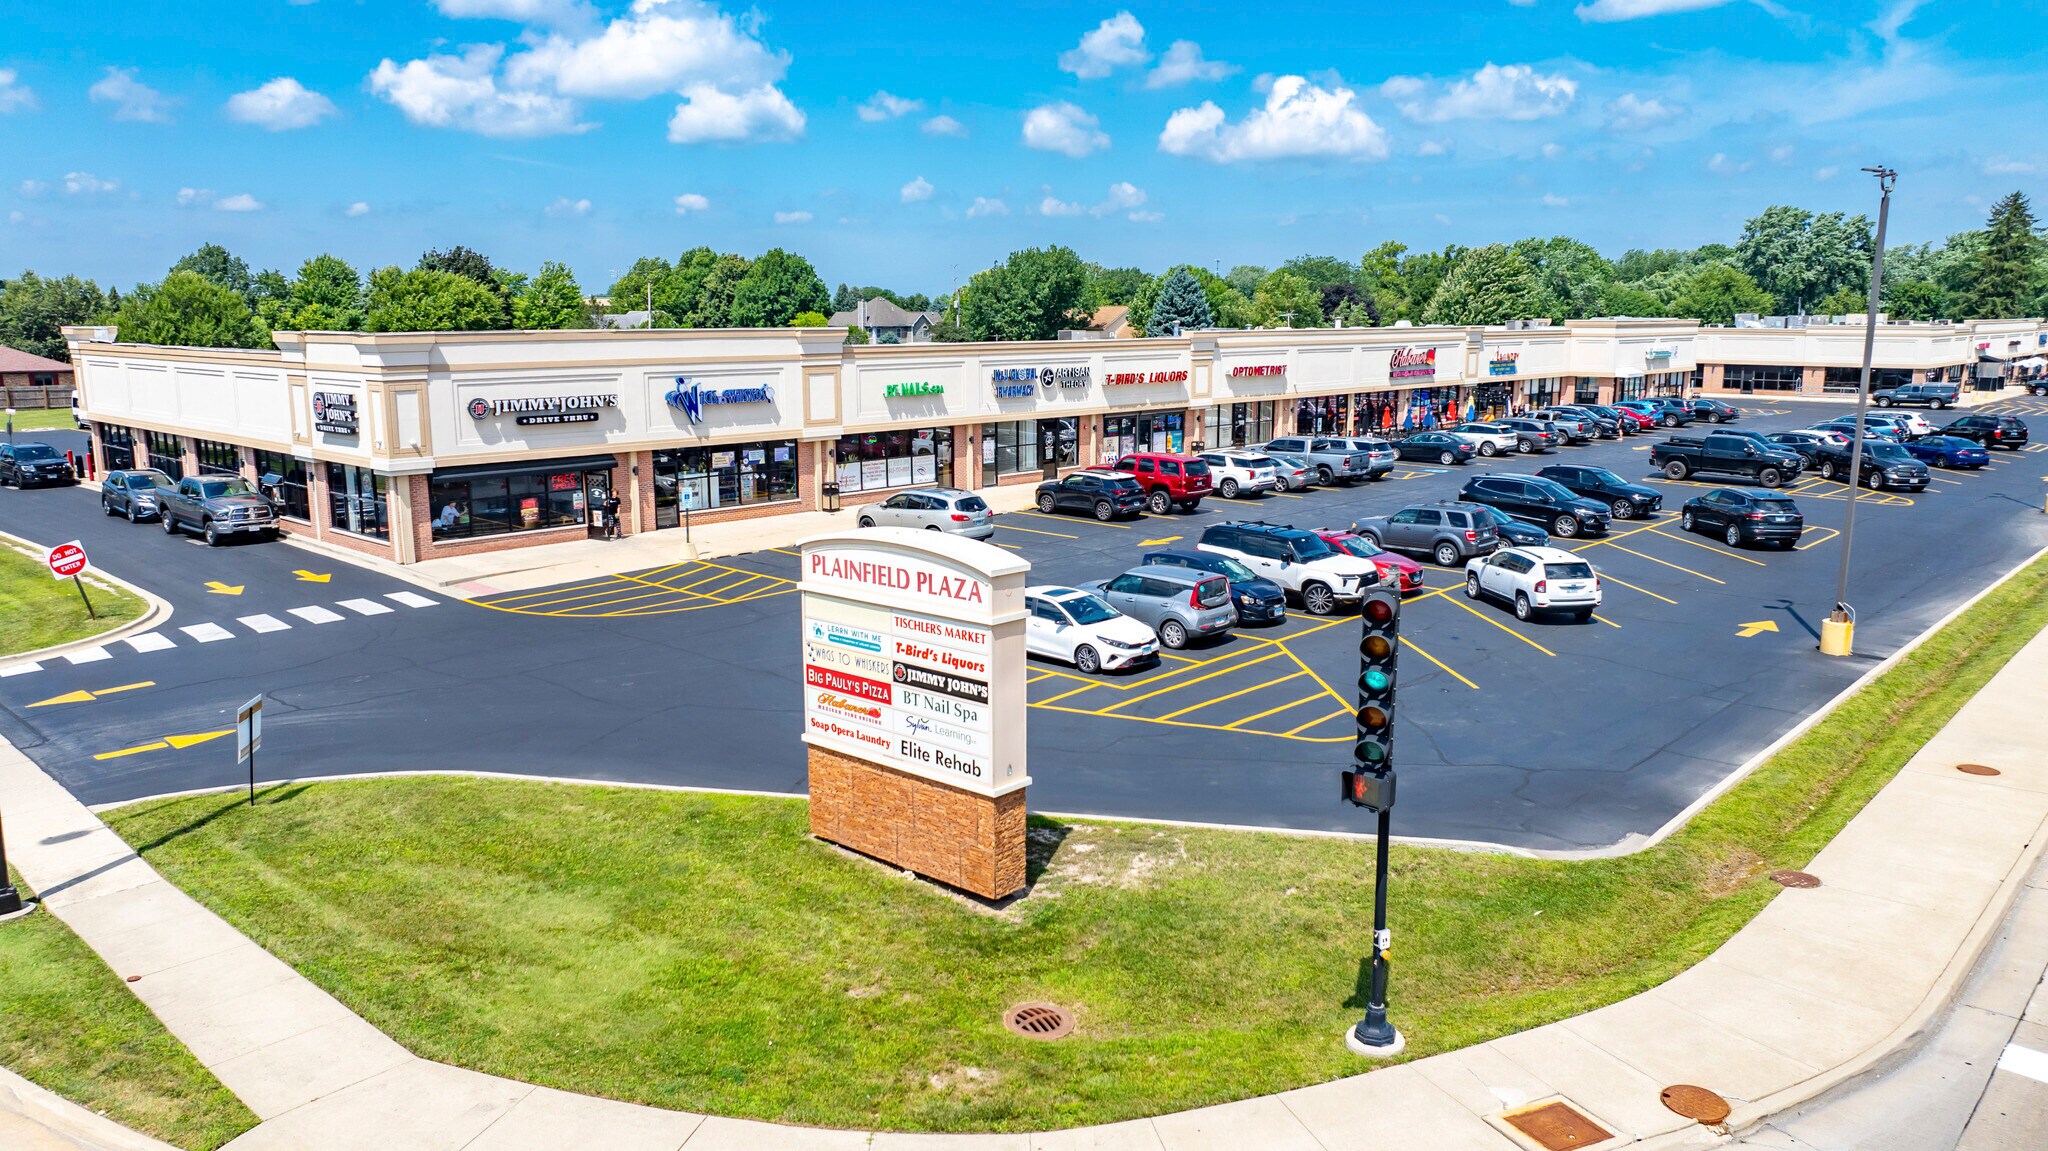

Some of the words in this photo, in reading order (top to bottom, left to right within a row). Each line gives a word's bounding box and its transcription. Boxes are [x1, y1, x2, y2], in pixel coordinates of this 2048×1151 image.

[1056, 367, 1090, 378] ARTISAN
[1105, 373, 1145, 385] T-BIRD'S
[1149, 370, 1188, 383] LIQUORS
[1232, 365, 1287, 377] OPTOMETRIST
[901, 382, 931, 396] NAILS
[1062, 379, 1087, 388] THEORY
[996, 385, 1034, 398] PHARMACY
[324, 393, 350, 407] JIMMY
[494, 397, 556, 416] JIMMY
[558, 395, 618, 412] JOHN'S
[325, 407, 352, 422] JOHN'S
[563, 414, 588, 422] THRU
[552, 474, 575, 484] FREE
[64, 548, 77, 556] NOT
[60, 561, 81, 572] ENTER
[812, 554, 910, 590] PLAINFIELD
[916, 571, 982, 604] PLAZA
[828, 624, 849, 635] LEARN
[851, 630, 868, 640] WITH
[894, 616, 942, 636] TISCHLER'S
[945, 627, 987, 645] MARKET
[816, 649, 834, 662] WAGS
[838, 653, 850, 665] TO
[855, 657, 889, 675] WHISKERS
[896, 642, 938, 662] T-Bird's
[941, 652, 985, 673] Liquors
[808, 668, 824, 684] BIG
[825, 672, 860, 693] PAULY'S
[862, 682, 889, 701] PIZZA
[906, 668, 945, 688] JIMMY
[947, 677, 988, 698] JOHN'S
[904, 690, 920, 706] BT
[924, 695, 950, 715] Nail
[954, 703, 978, 723] Spa
[811, 717, 829, 732] Soap
[831, 723, 854, 737] Opera
[857, 730, 891, 749] Laundry
[906, 715, 932, 735] Sylvan
[935, 724, 971, 745] Learning
[901, 740, 930, 762] Elite
[936, 749, 981, 777] Rehab
